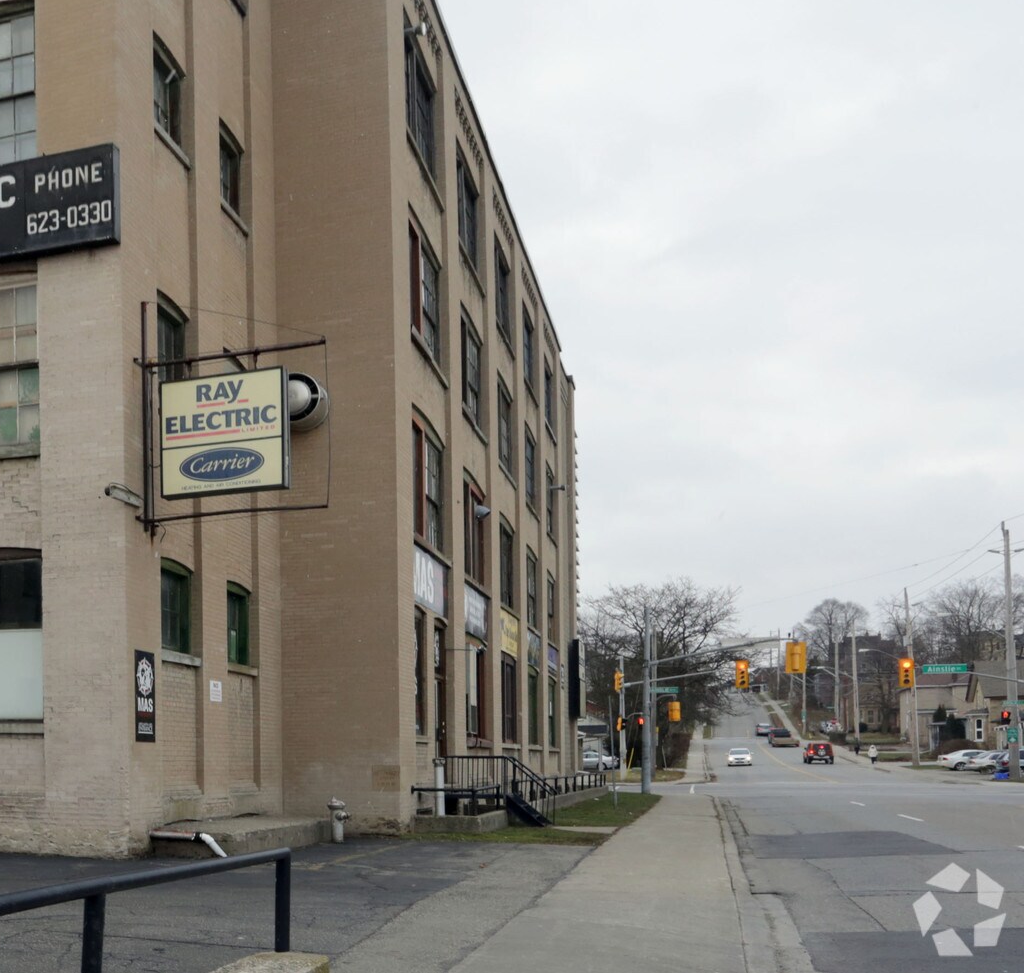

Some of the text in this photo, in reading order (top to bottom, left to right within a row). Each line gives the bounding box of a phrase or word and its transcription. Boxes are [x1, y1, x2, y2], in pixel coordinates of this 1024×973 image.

[35, 162, 103, 194] PHONE
[27, 200, 112, 235] 623-0330
[196, 379, 244, 403] RAY
[165, 404, 277, 435] ELECTRIC
[241, 424, 276, 434] LIMITED
[189, 453, 256, 474] Carrier
[137, 697, 154, 713] MAS
